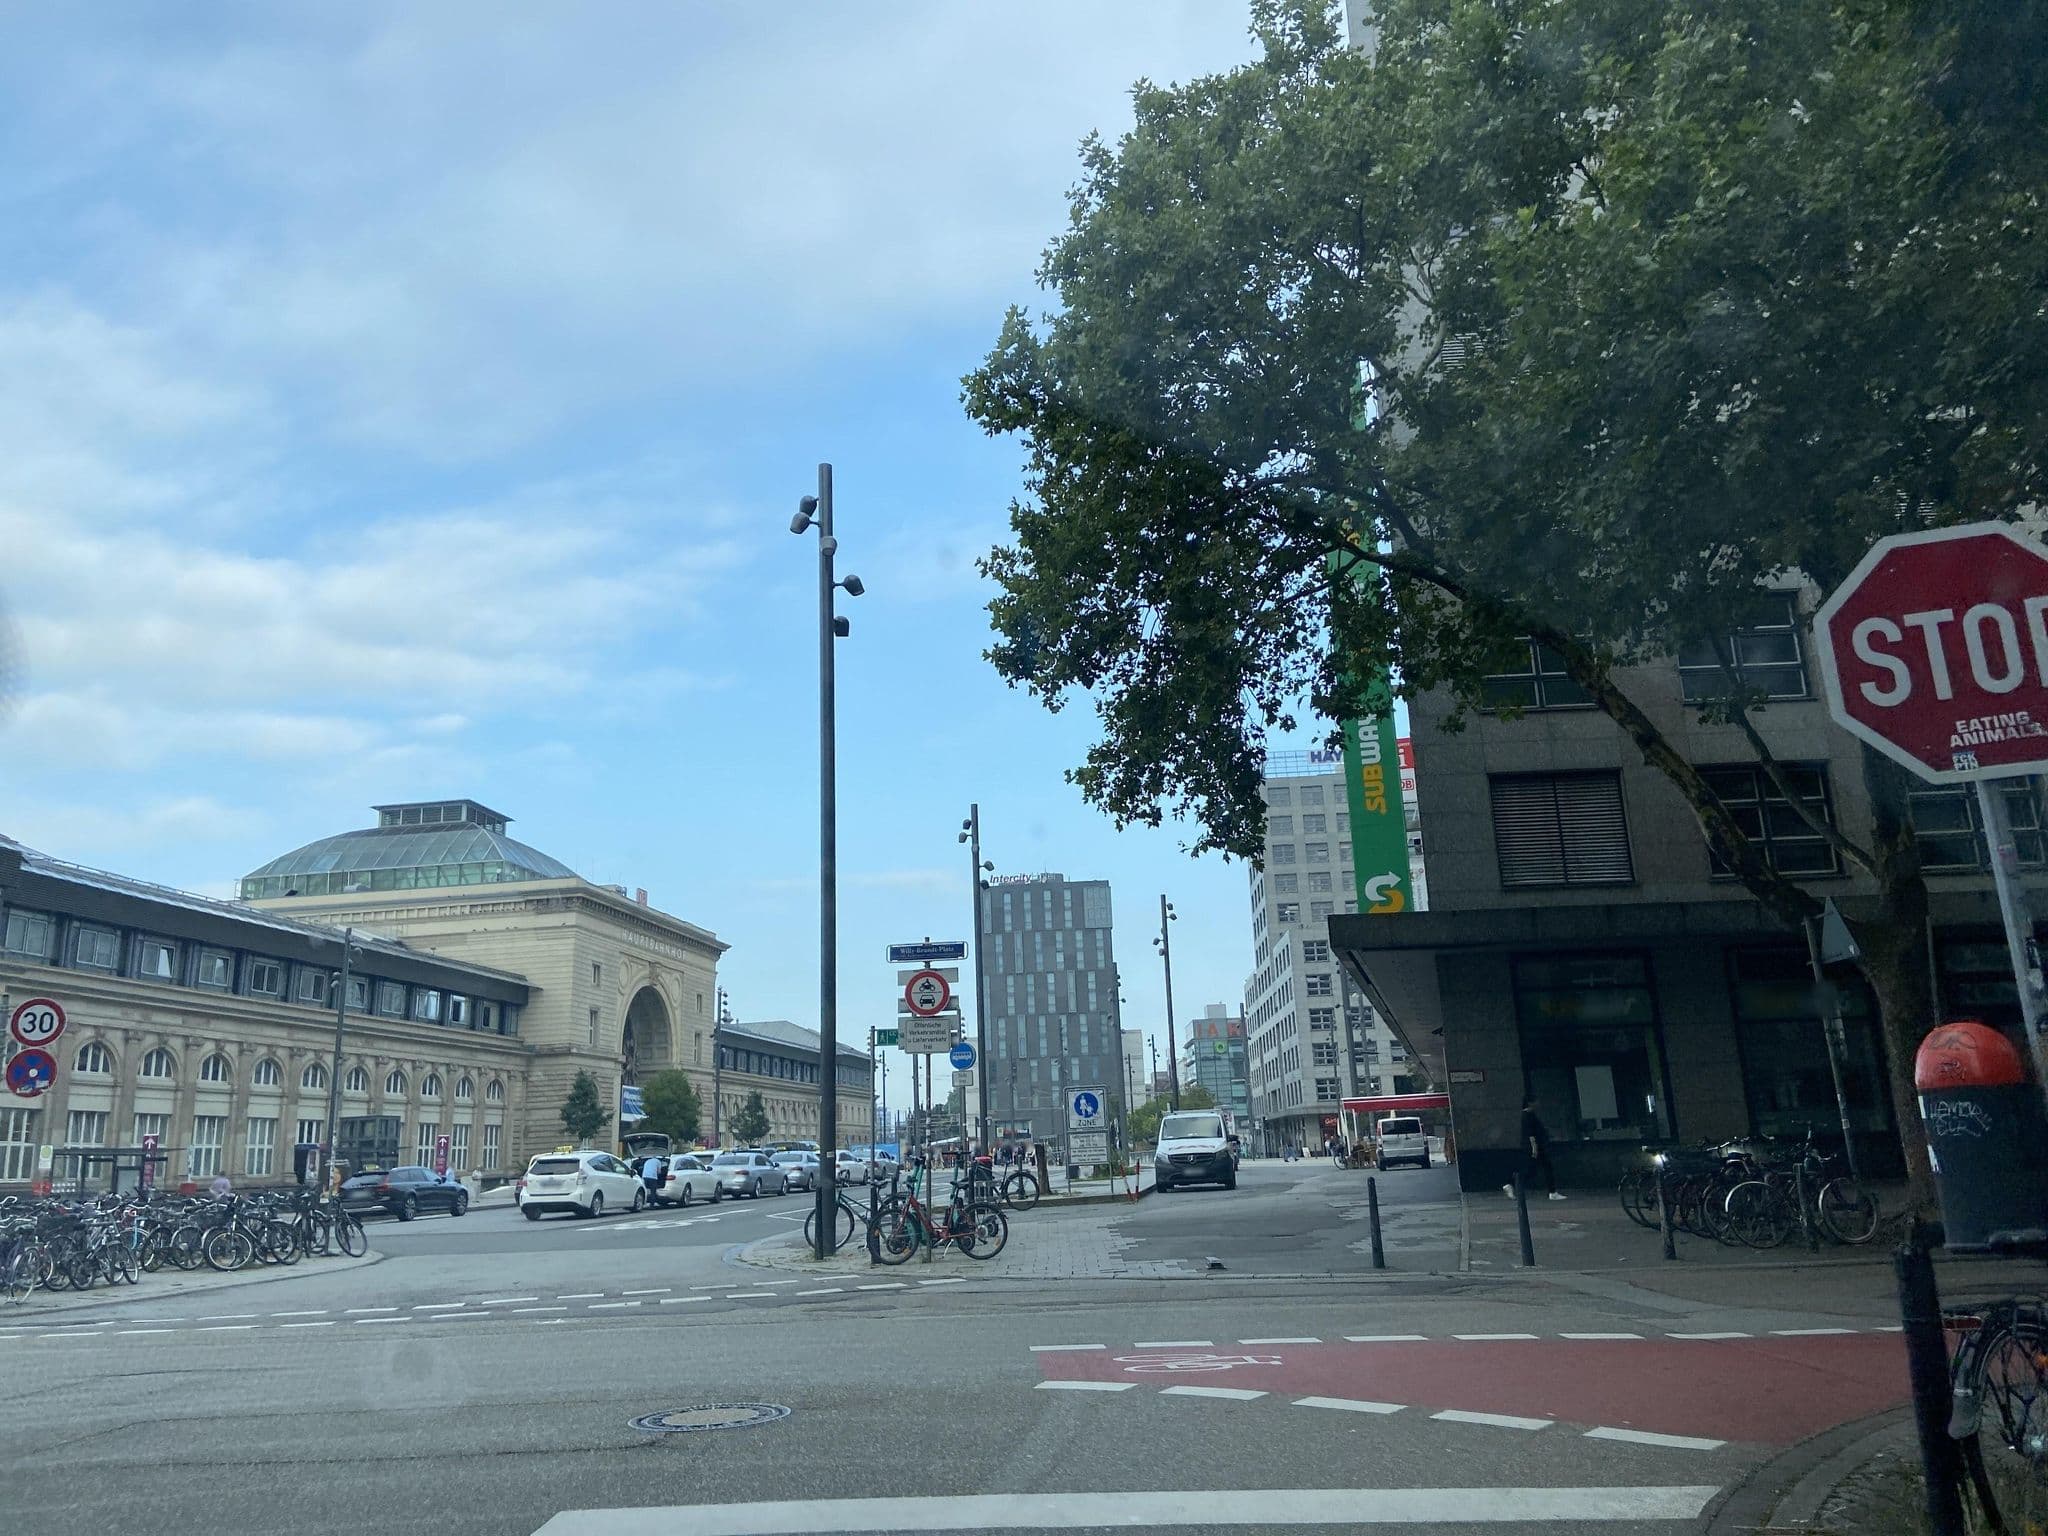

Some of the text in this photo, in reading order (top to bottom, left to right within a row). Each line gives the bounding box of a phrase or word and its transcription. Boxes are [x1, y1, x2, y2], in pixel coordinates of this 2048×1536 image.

[1955, 711, 2030, 734] EATING
[622, 929, 686, 960] HAUPTBAHNHOF
[22, 1012, 54, 1033] 30
[1078, 1119, 1097, 1127] ZONE
